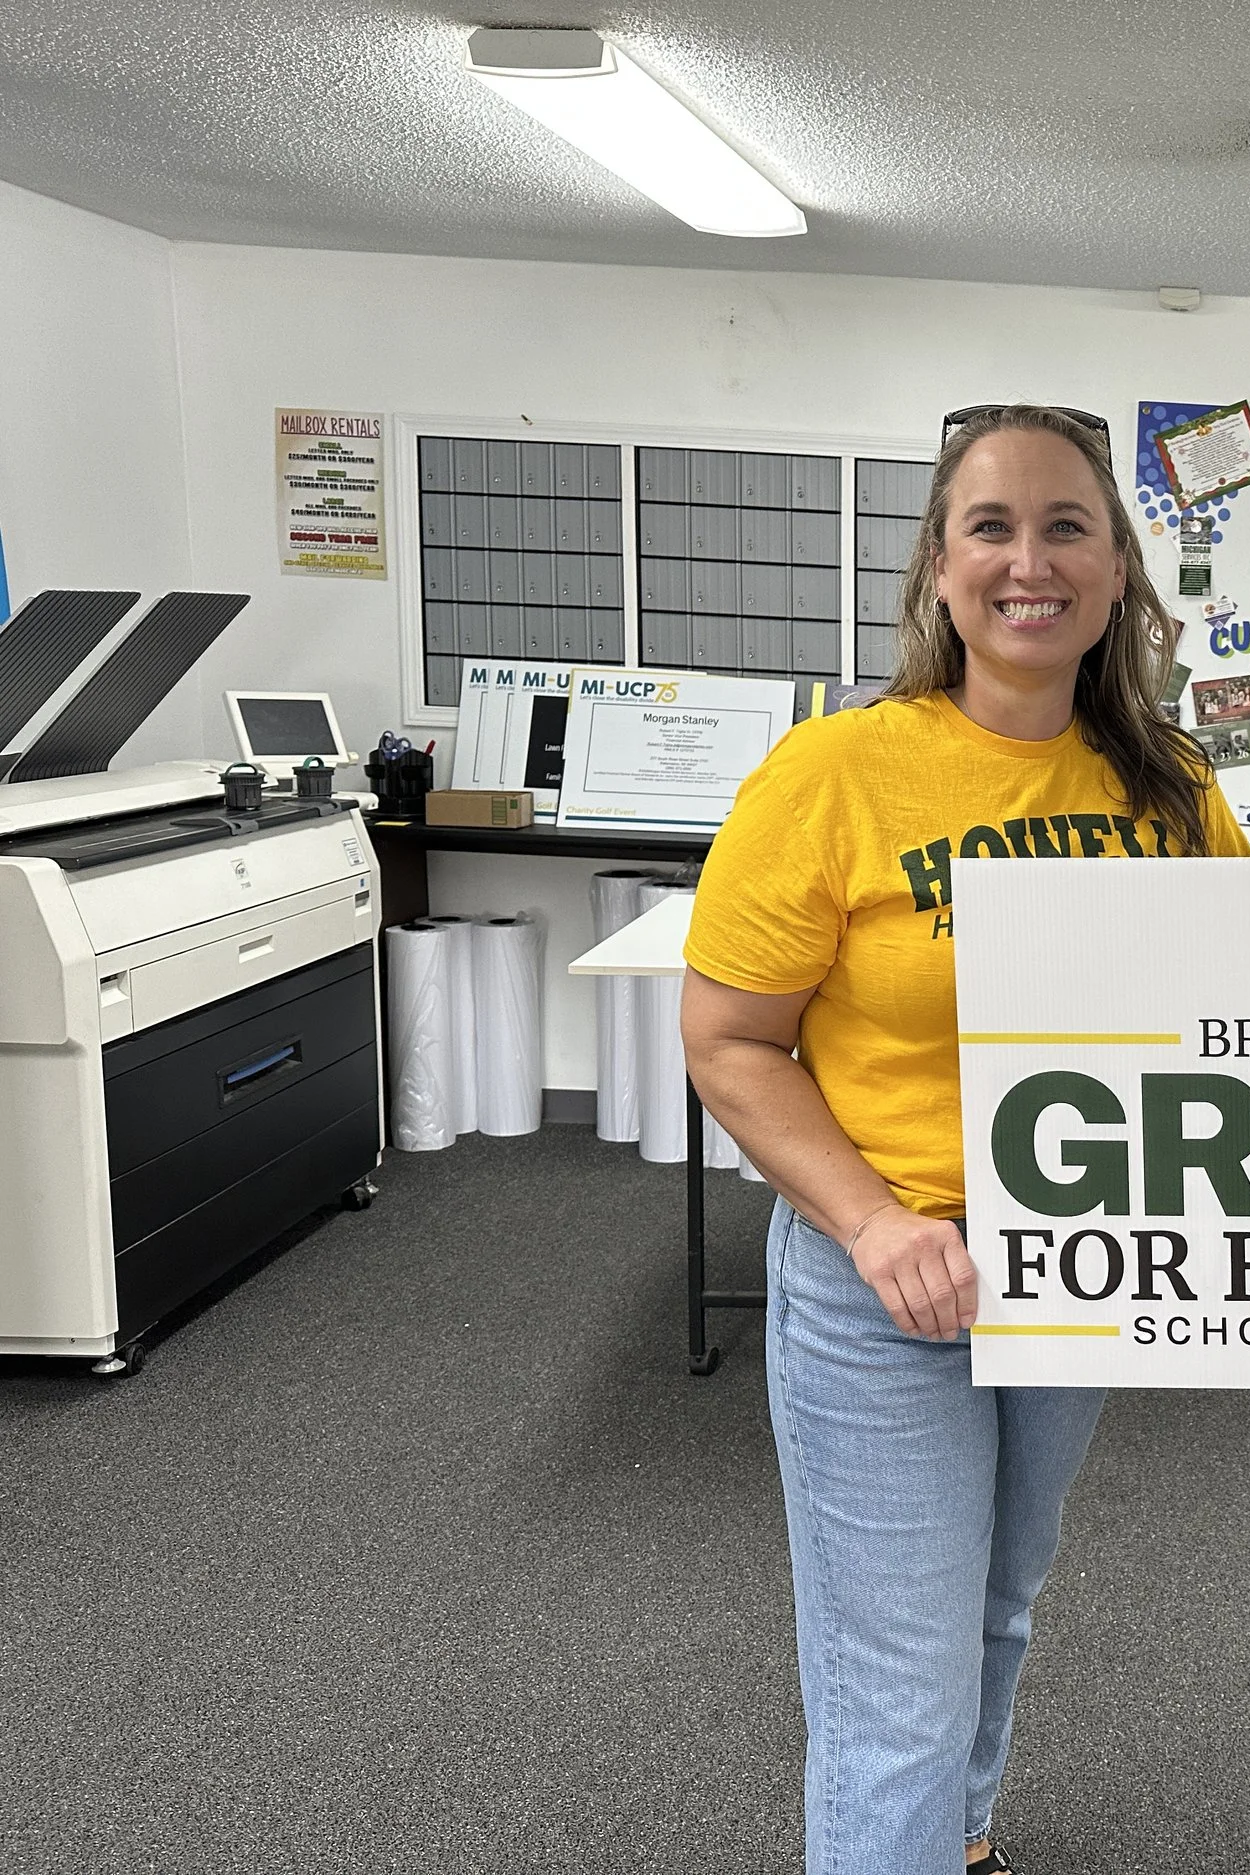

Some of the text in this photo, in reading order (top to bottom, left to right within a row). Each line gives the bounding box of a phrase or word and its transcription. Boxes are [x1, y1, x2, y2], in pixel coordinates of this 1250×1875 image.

[281, 415, 380, 437] MAILBOX RENTALS
[580, 679, 656, 697] MI-UCP
[643, 713, 719, 728] Morgan Stanley
[1220, 751, 1231, 762] 23
[1237, 750, 1249, 760] 26
[566, 806, 636, 816] Charity Golf Event
[899, 813, 1172, 913] HOWEL
[1002, 1229, 1197, 1302] FOR
